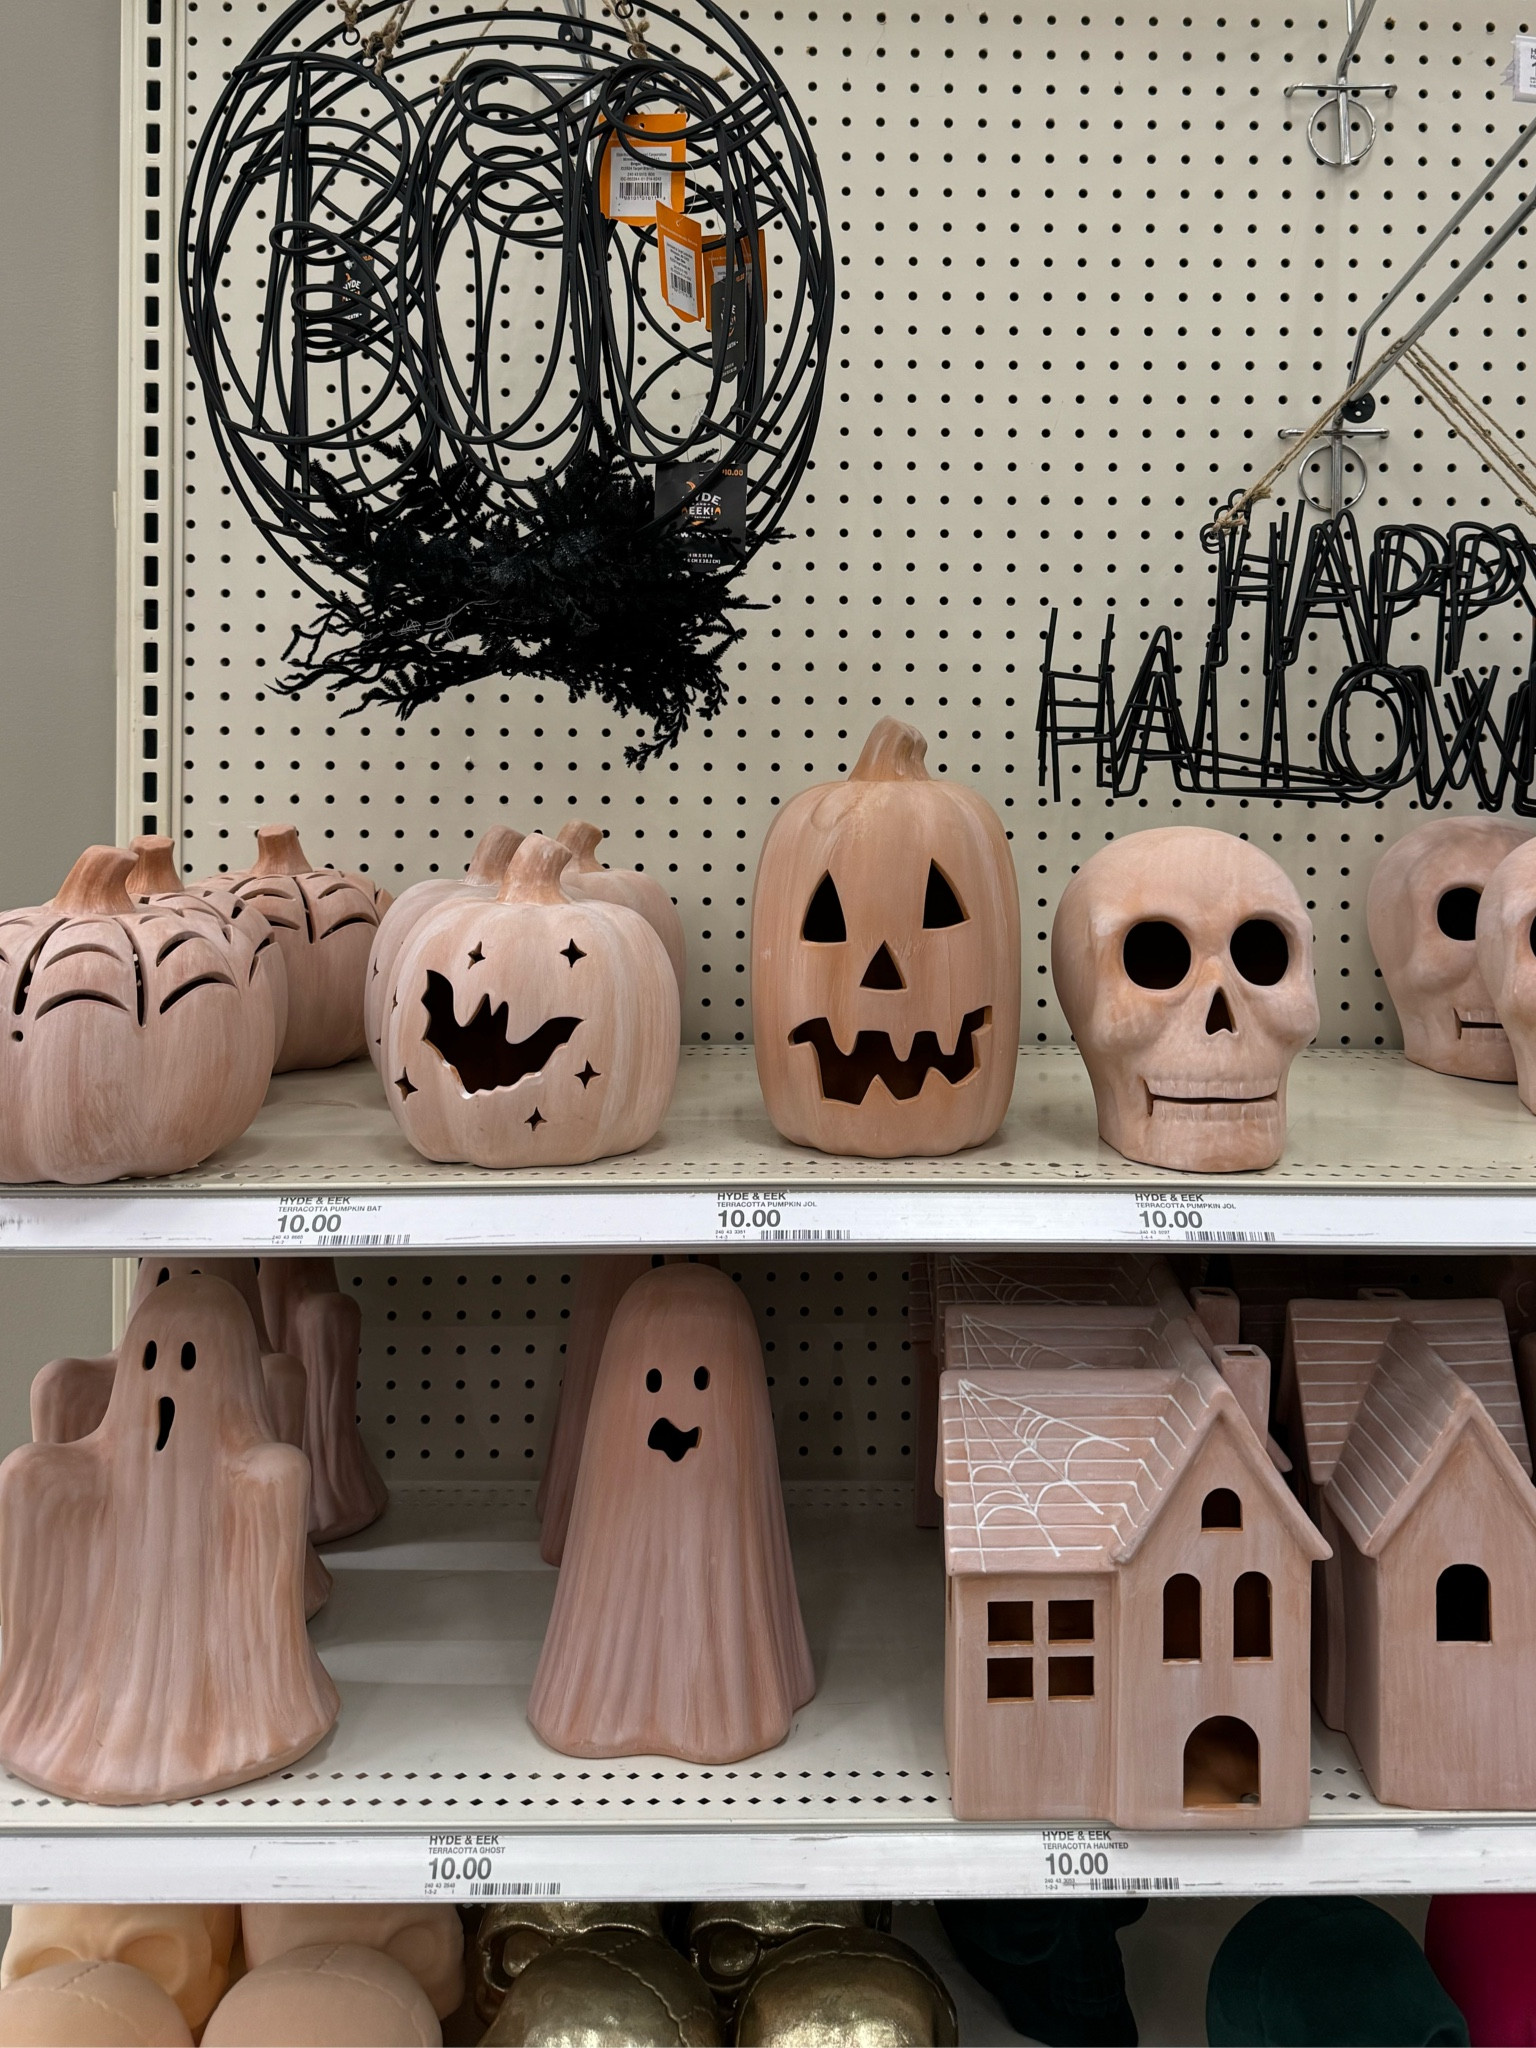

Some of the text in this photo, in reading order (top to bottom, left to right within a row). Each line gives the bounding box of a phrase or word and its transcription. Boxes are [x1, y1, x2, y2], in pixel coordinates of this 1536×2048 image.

[688, 506, 714, 516] EEK!
[279, 1196, 352, 1205] HYDE & EEK
[717, 1192, 787, 1201] HYDE & EEK
[1135, 1193, 1205, 1202] HYDE & EEK
[277, 1214, 342, 1233] 10.00
[718, 1209, 781, 1228] 10.00
[1139, 1210, 1203, 1229] 10.00
[429, 1835, 500, 1845] HYDE & EEK
[1042, 1830, 1112, 1841] HYDE & EEK
[1043, 1842, 1129, 1850] TERRACOTTA HAUNTED
[428, 1856, 492, 1880] 10.00
[1045, 1852, 1109, 1876] 10.00
